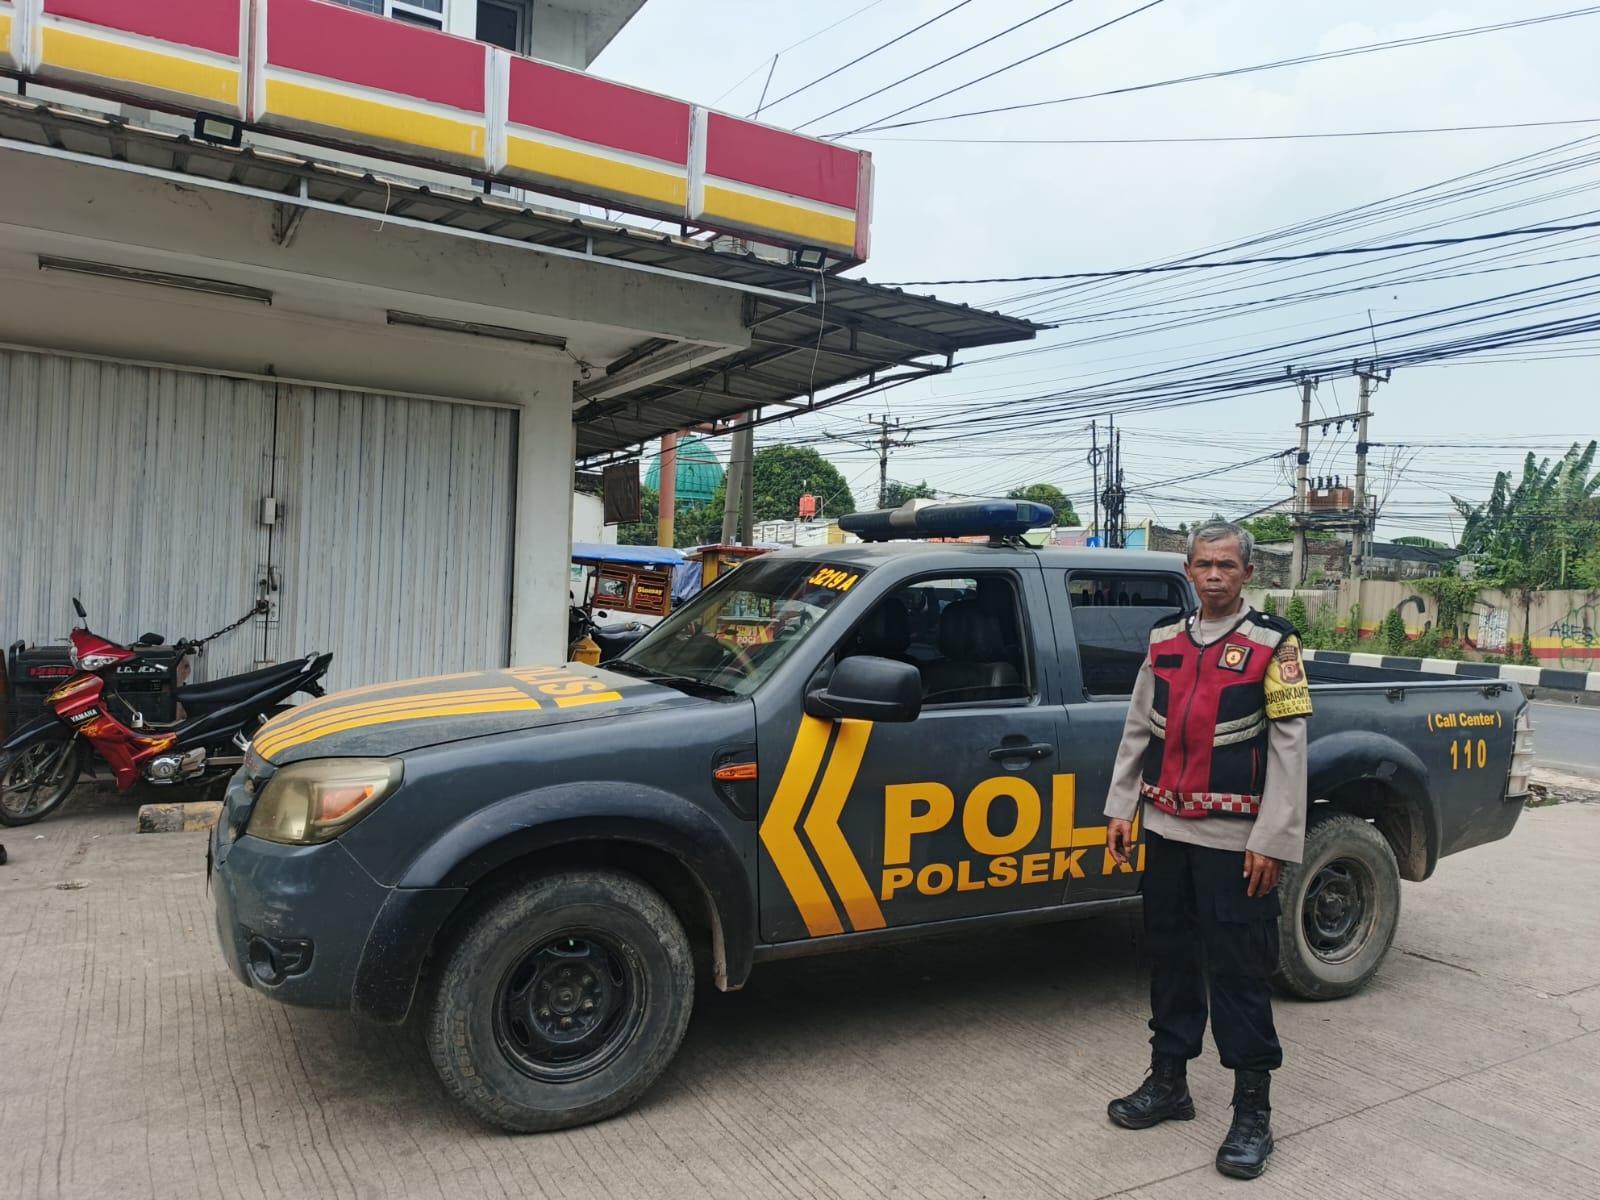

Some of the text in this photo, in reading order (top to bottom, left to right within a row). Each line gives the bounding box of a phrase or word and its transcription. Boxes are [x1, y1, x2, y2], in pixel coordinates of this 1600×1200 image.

[808, 568, 859, 591] 3219 A
[70, 708, 98, 722] YAMAHA
[1450, 738, 1487, 770] 110
[881, 849, 1087, 901] POLSEK
